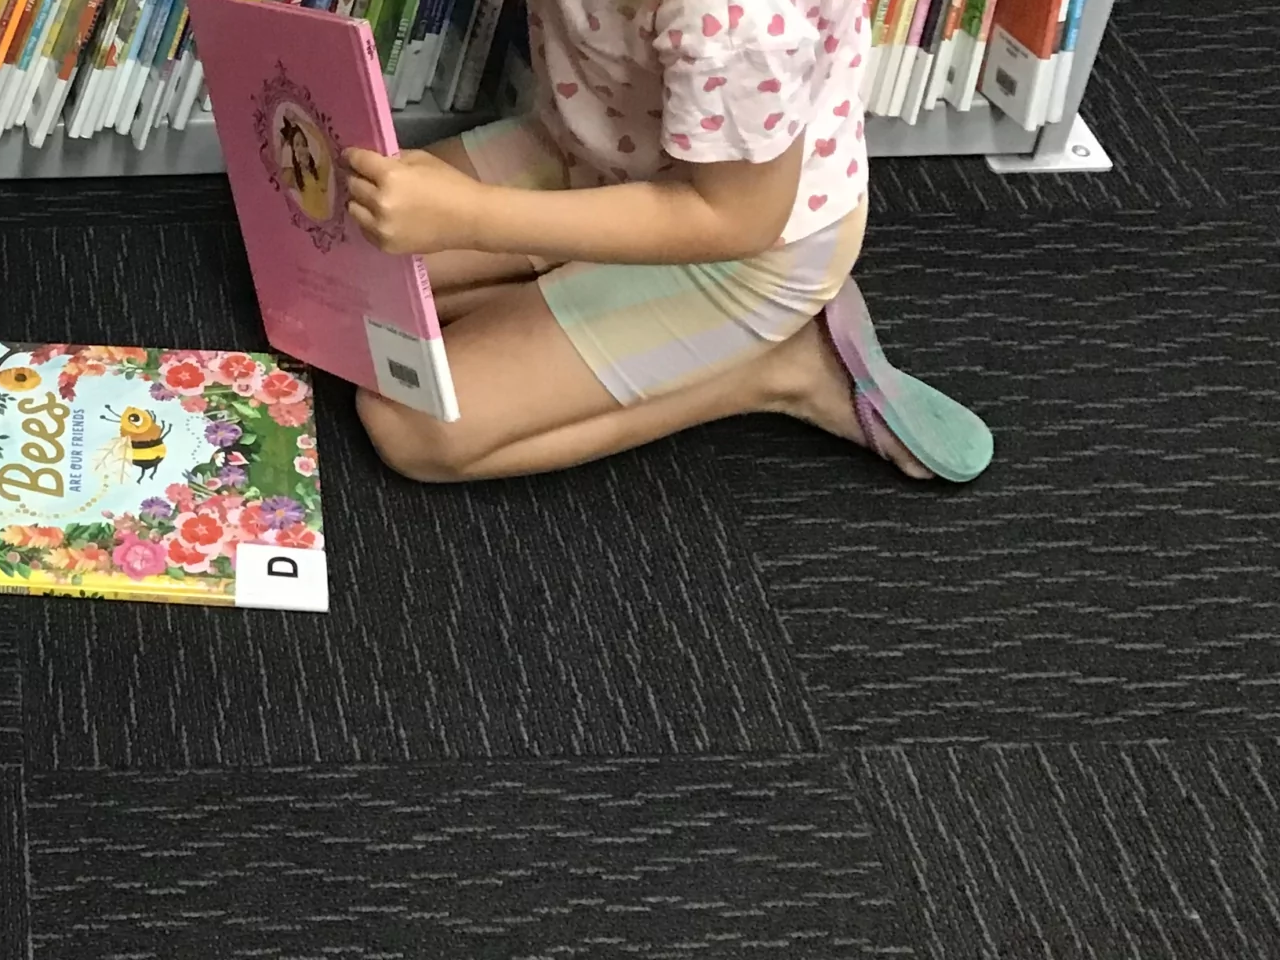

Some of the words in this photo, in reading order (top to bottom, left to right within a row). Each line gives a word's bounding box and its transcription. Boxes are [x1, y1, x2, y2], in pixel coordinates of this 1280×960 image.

[72, 408, 85, 442] FRIENDS
[71, 444, 84, 470] OUR
[68, 470, 83, 494] ARE
[267, 556, 298, 579] D
